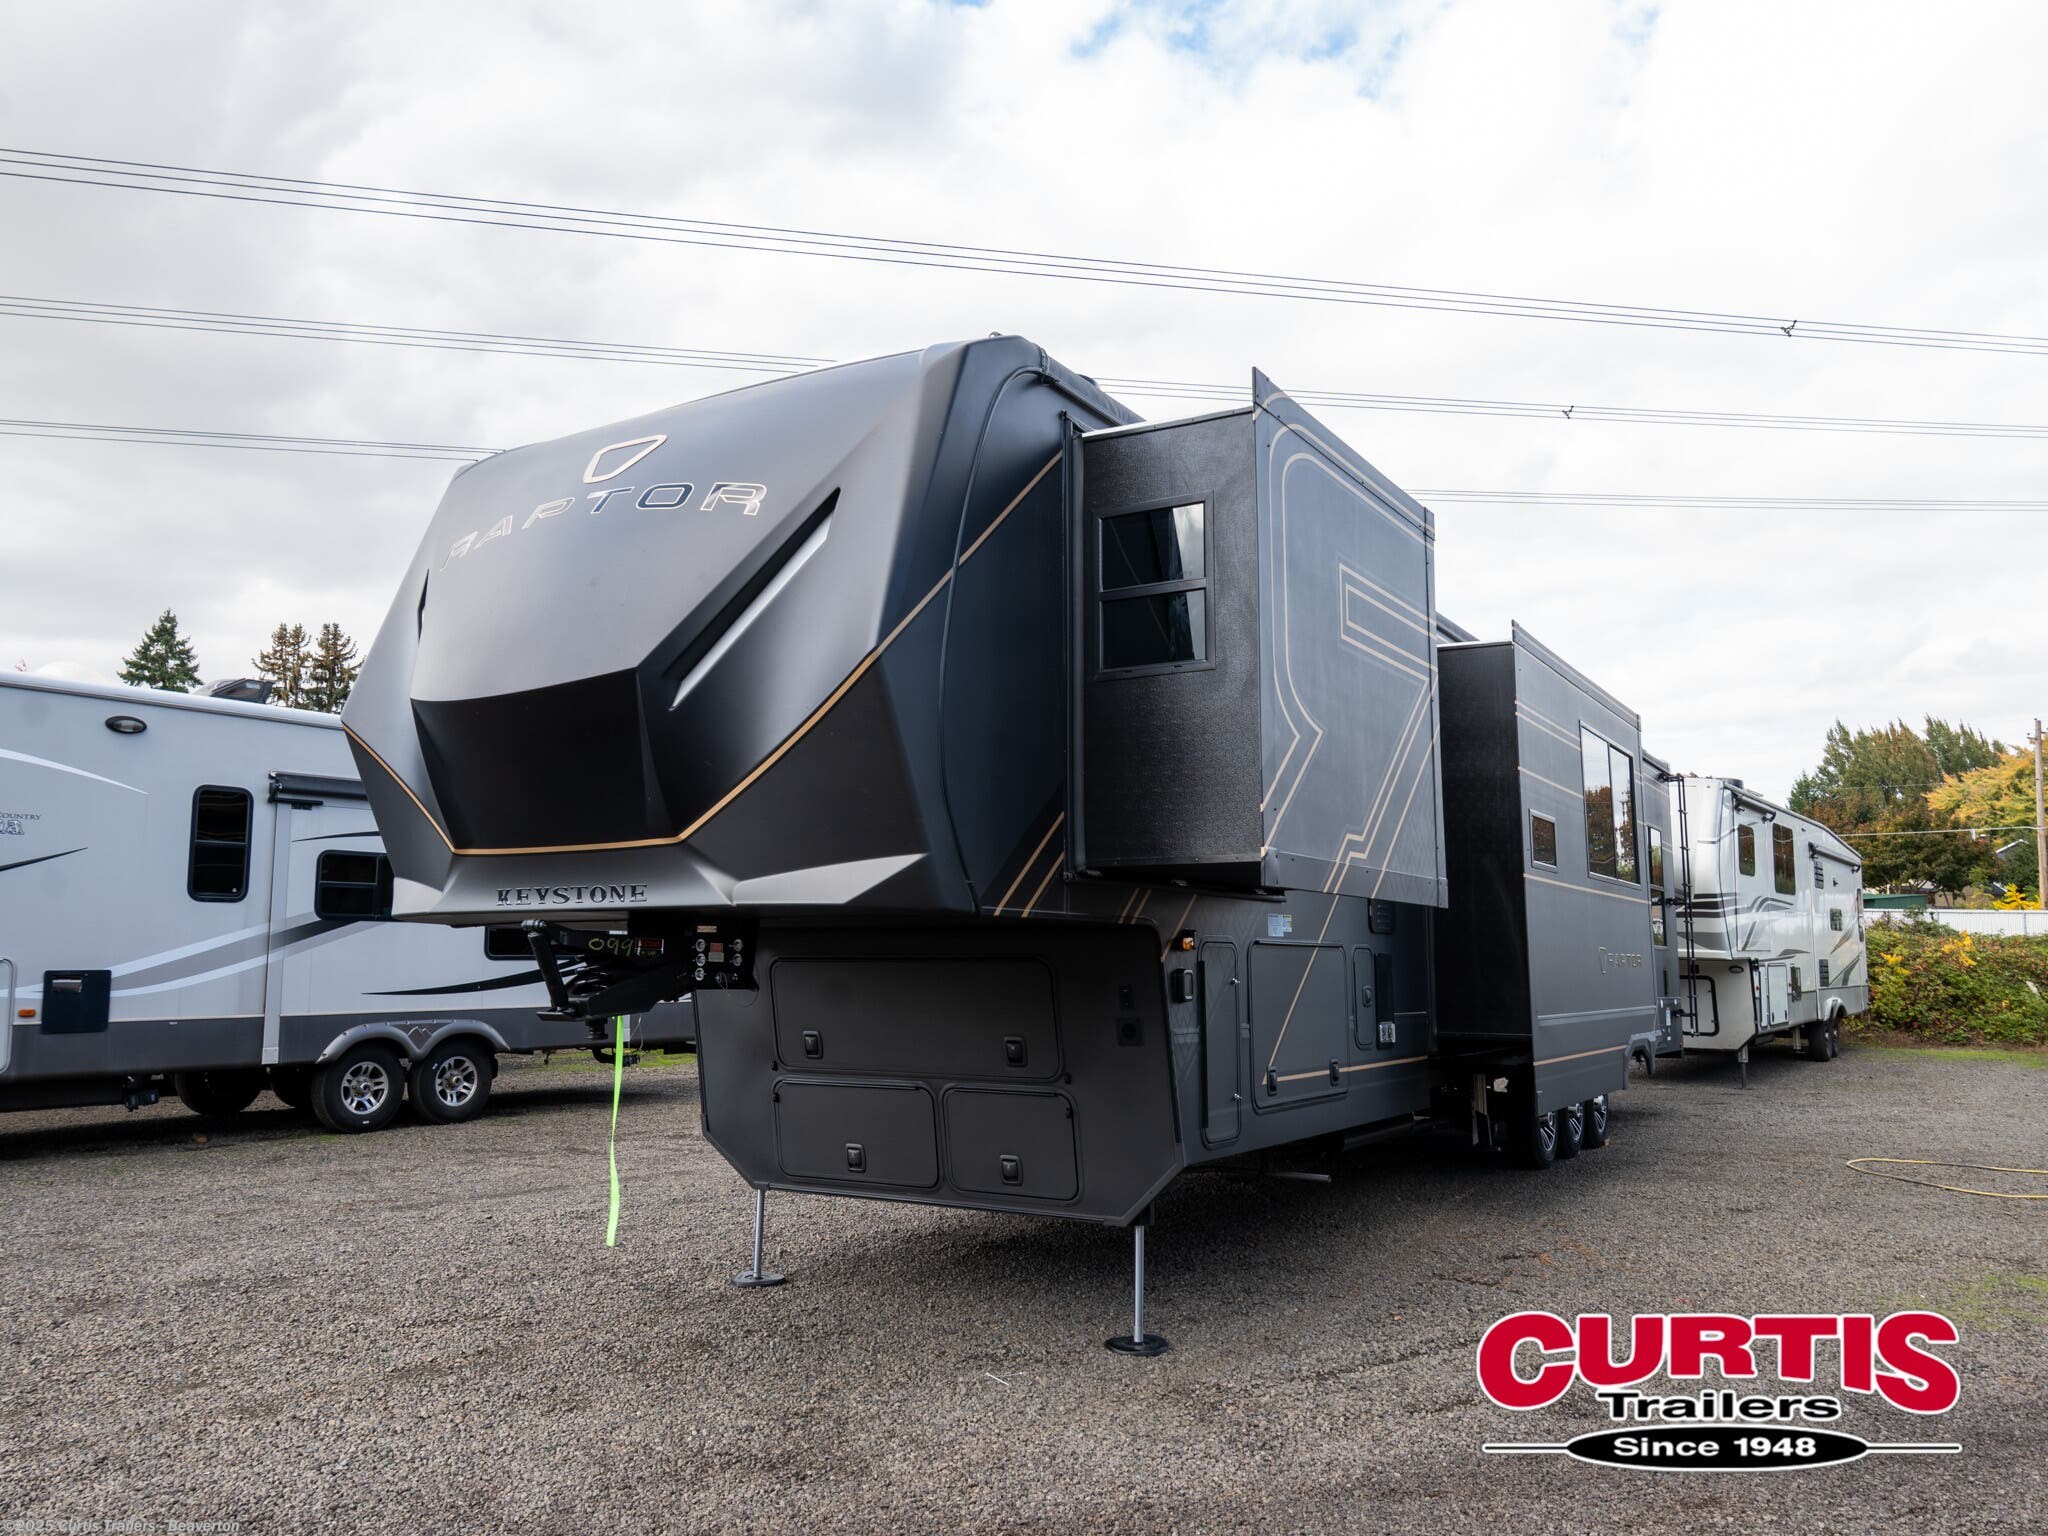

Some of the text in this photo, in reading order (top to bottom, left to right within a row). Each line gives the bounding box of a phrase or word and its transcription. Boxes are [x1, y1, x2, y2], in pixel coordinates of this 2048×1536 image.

[440, 482, 767, 572] RAPTOR
[0, 811, 42, 821] OUNTRY
[496, 884, 648, 907] KEYSTONE
